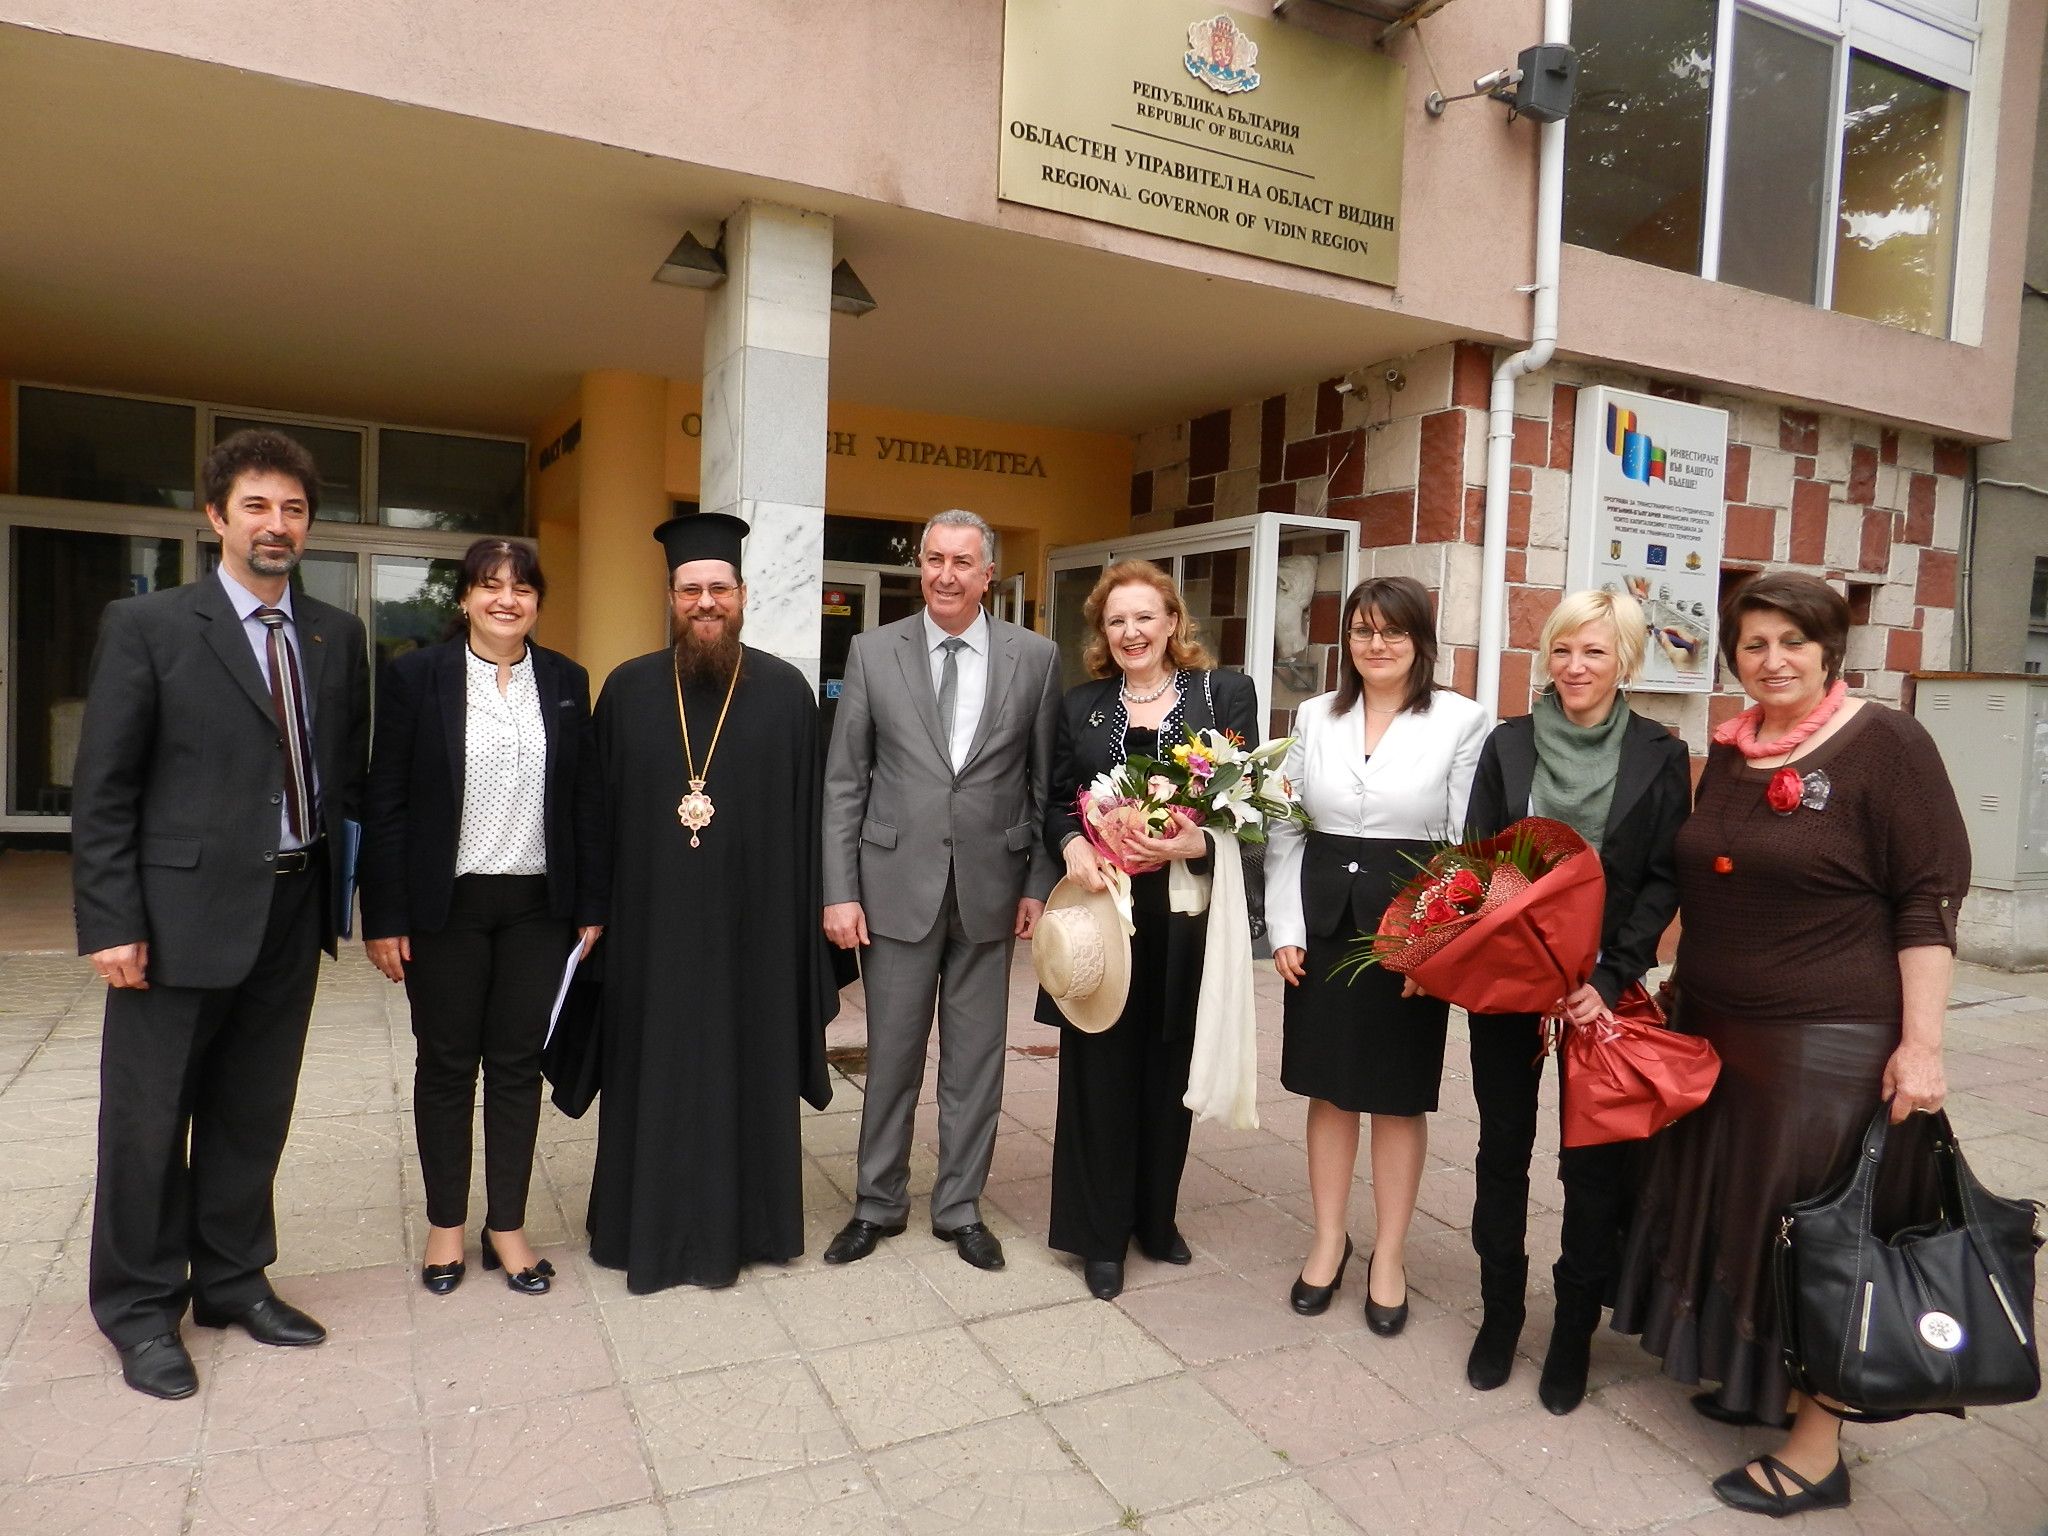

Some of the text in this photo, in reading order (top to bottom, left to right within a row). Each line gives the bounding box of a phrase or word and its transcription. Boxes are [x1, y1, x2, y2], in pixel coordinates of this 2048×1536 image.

[1132, 80, 1300, 139] РЕПУБЛИКА БЪЛГАРИЯ
[1136, 102, 1295, 155] REPUBLIC OF BULGARIA
[1010, 120, 1395, 232] ОБЛАСТЕН УПРАВИТЕЛ НА ОБЛАСТ ВИДИН
[1041, 164, 1369, 255] REGIONAL GOVERNOR OF VIDIN REGION
[876, 436, 1047, 478] УПРАВИТЕЛ
[1670, 448, 1719, 465] ИНВЕСТИРАНЕ
